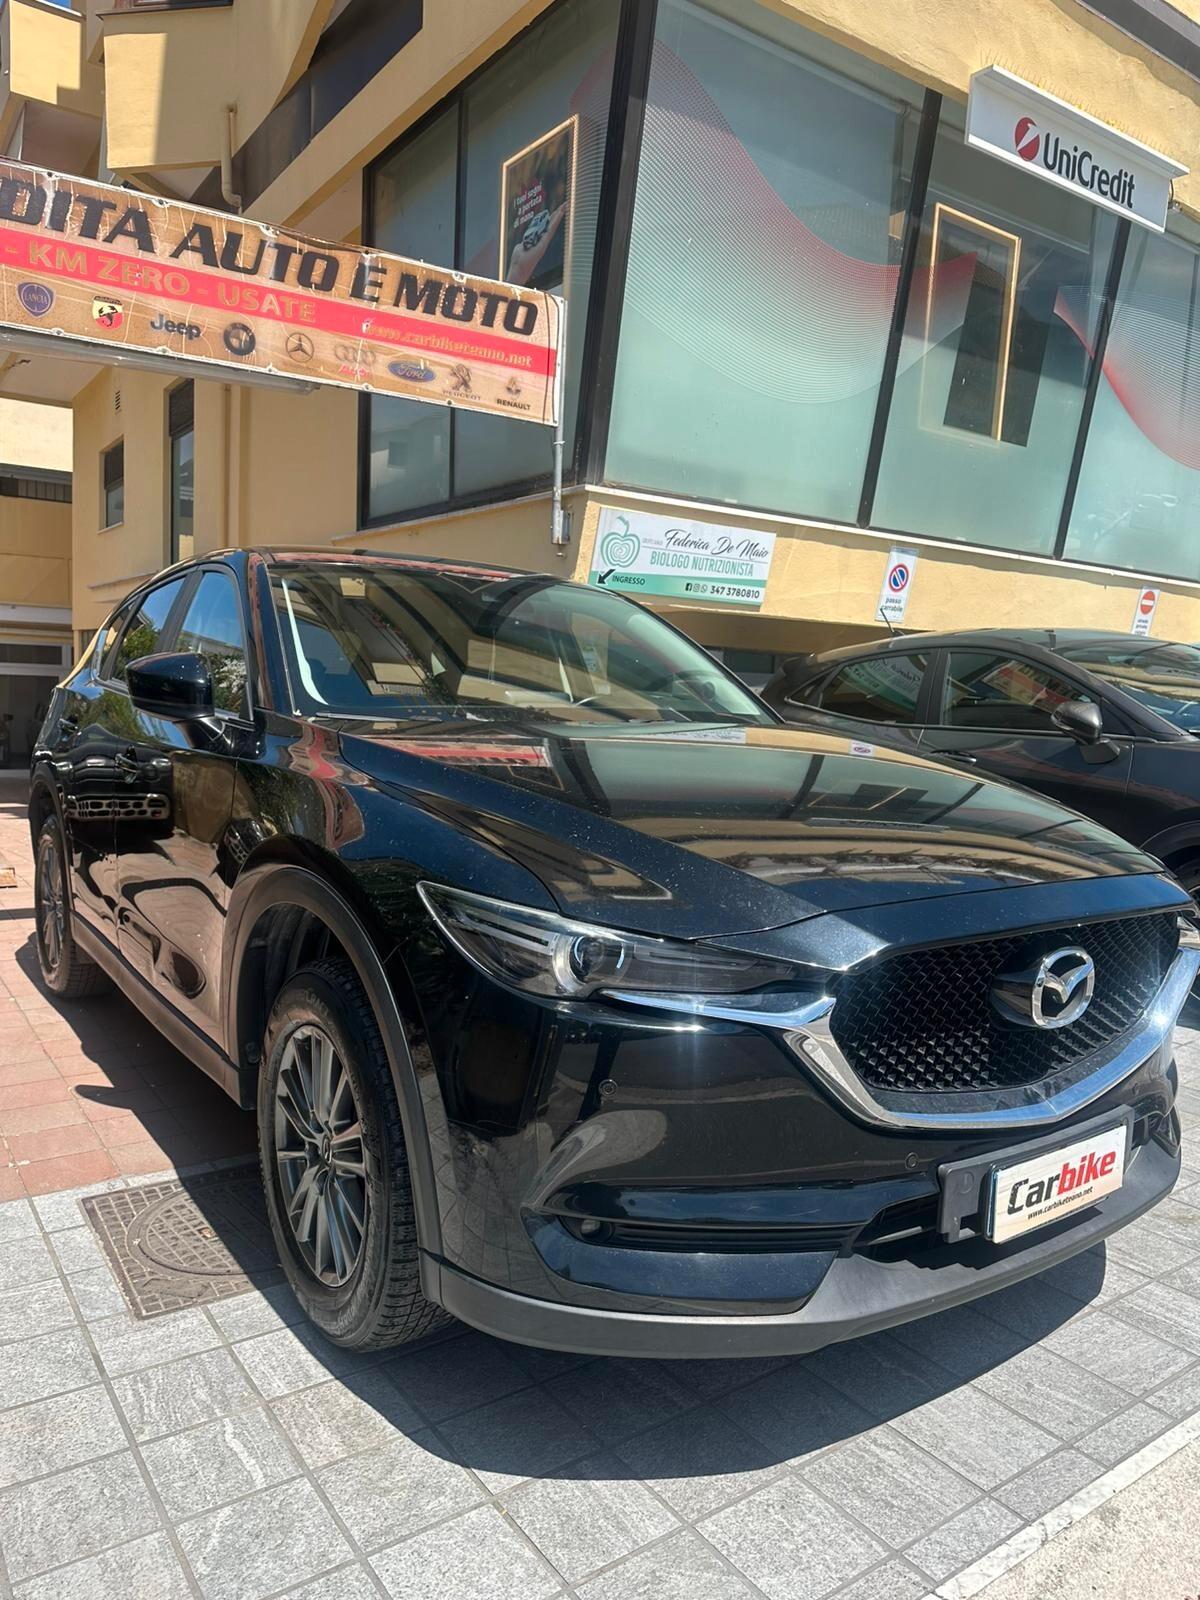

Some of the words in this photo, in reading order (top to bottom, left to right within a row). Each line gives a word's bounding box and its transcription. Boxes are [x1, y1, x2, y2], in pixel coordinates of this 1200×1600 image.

[1042, 132, 1136, 209] UniCredit
[0, 176, 157, 254] DITA
[168, 222, 340, 292] AUTO
[349, 261, 388, 304] E
[393, 271, 540, 336] MOTO
[29, 240, 89, 276] KM
[96, 256, 191, 297] ZERO
[217, 282, 317, 325] USATE
[150, 313, 202, 341] Jeep
[396, 362, 427, 381] Ford
[496, 398, 532, 411] RENAULT
[664, 528, 711, 551] Federica
[711, 536, 733, 555] De
[732, 538, 769, 560] Maio
[650, 550, 690, 569] BIOLOGO
[690, 555, 754, 577] NUTRIZIONISTA
[611, 575, 646, 586] INGRESSO
[709, 585, 726, 595] 347
[726, 586, 761, 599] 3780810
[1006, 1150, 1118, 1216] Carbike
[1027, 1186, 1094, 1221] www.carbiketeano.net
